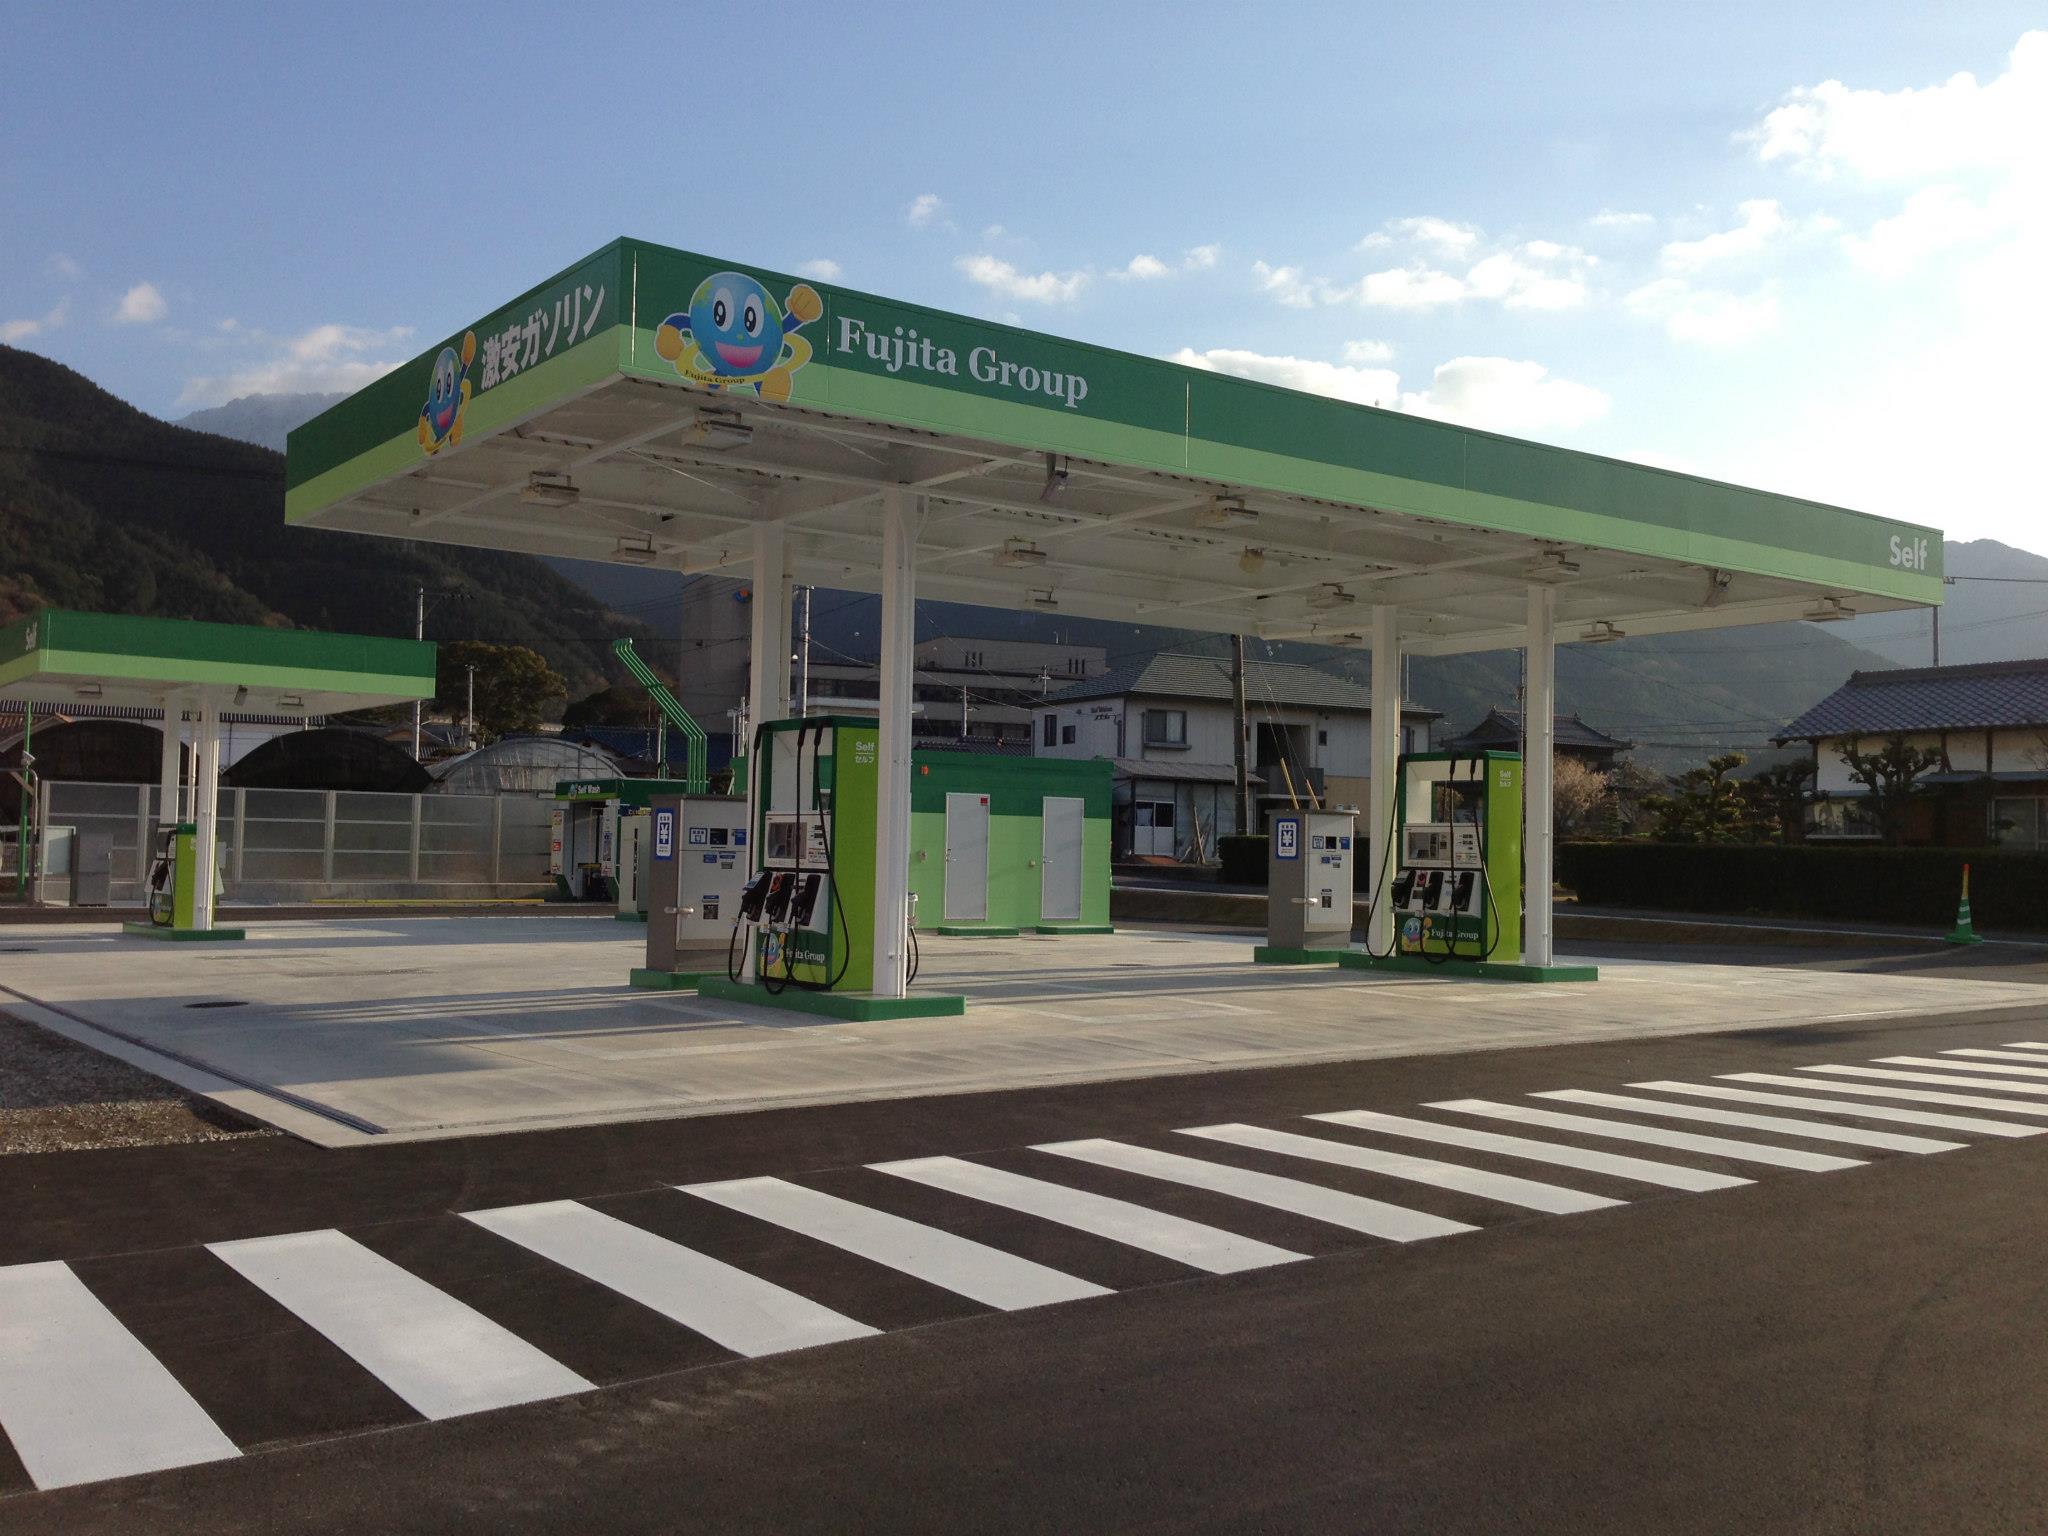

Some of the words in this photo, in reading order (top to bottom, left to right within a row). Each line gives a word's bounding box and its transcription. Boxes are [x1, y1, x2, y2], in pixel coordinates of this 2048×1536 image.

[481, 283, 605, 391] 激安ガソリン
[836, 316, 959, 373] Fujita
[968, 346, 1089, 408] Group
[685, 369, 713, 382] Fujita
[1890, 535, 1928, 570] Self
[856, 741, 875, 751] Self
[855, 755, 875, 763] セルフ
[804, 950, 826, 964] Group
